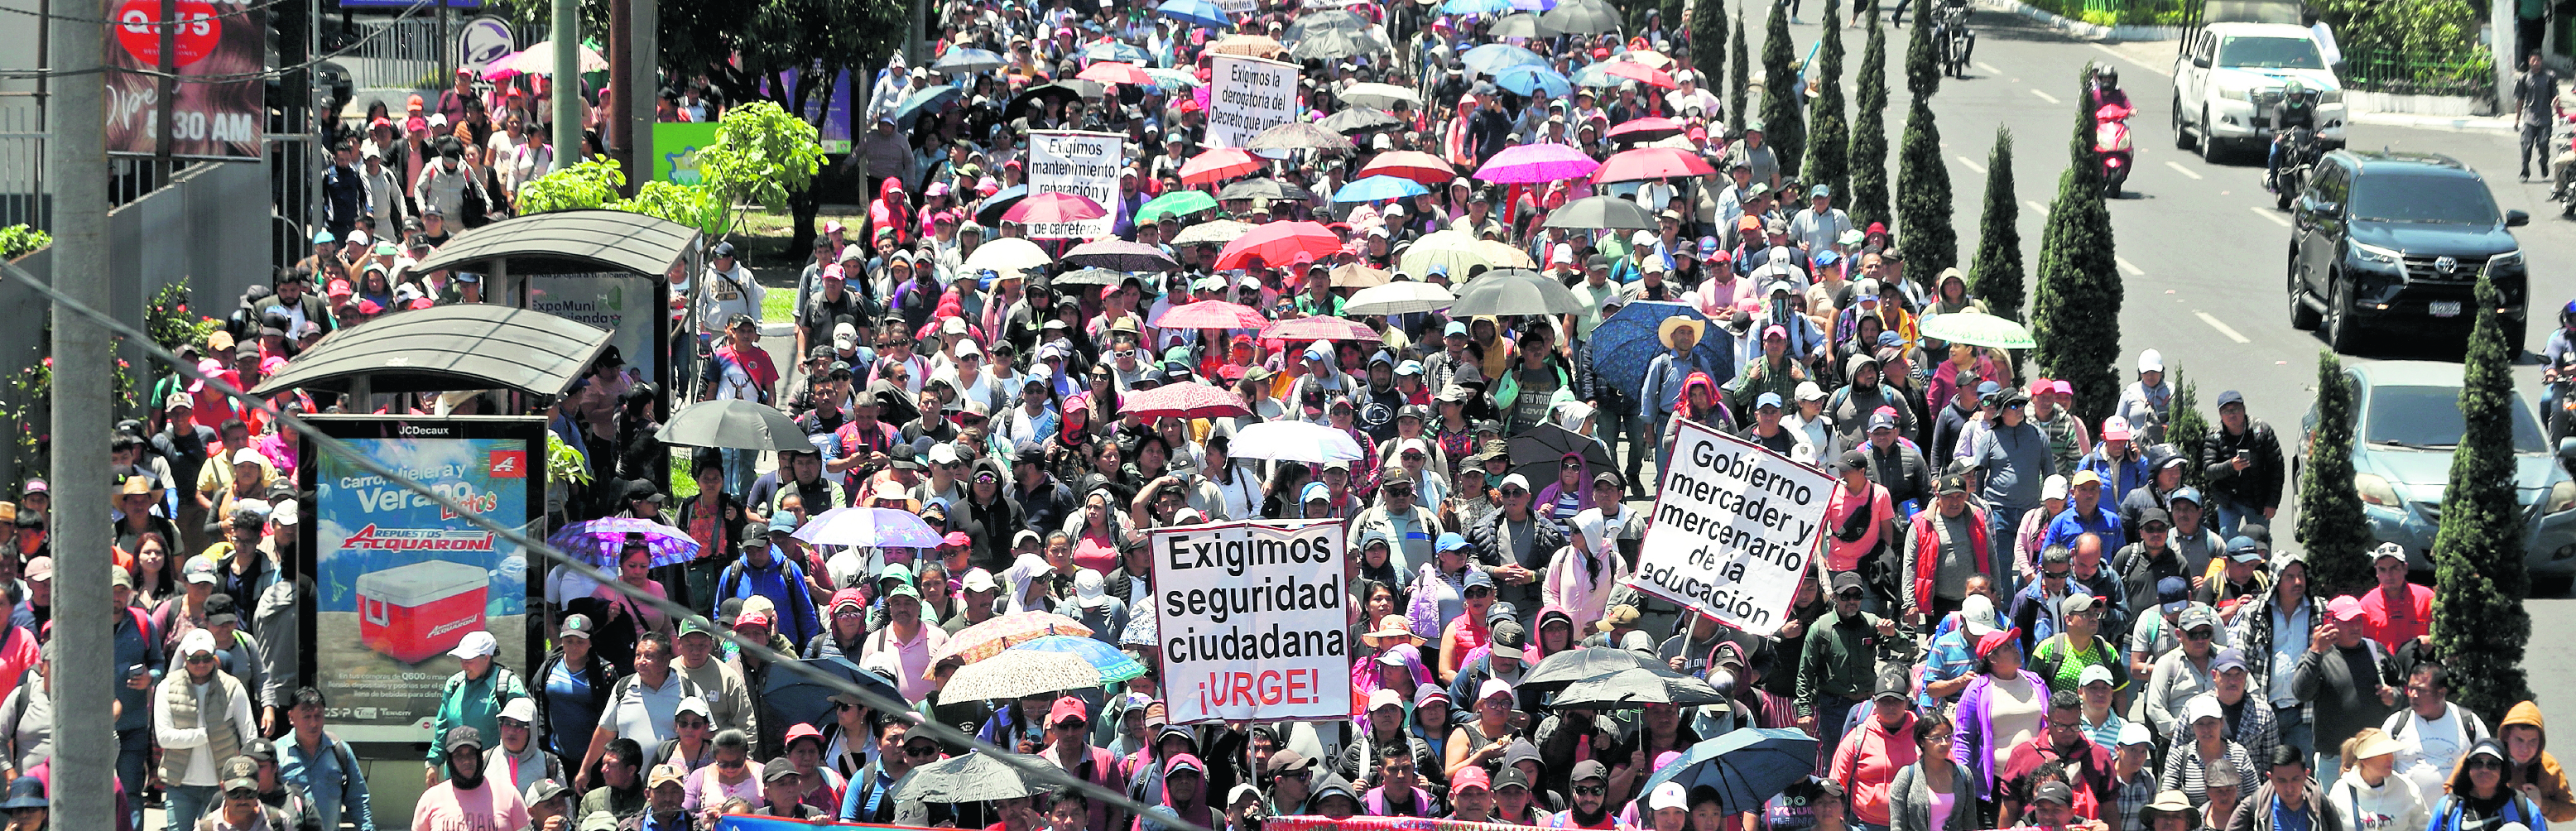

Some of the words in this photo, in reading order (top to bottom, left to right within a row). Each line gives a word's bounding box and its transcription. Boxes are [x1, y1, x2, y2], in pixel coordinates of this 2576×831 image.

[1232, 64, 1270, 89] Exigimos
[1272, 69, 1281, 89] la
[1222, 85, 1270, 111] derogatoria
[1271, 93, 1286, 112] del
[211, 112, 252, 142] AM
[1211, 105, 1242, 129] Decreto
[1243, 115, 1261, 134] que
[1049, 137, 1103, 159] Exigimos
[1031, 159, 1118, 181] mantenimiento,
[1102, 186, 1109, 204] y
[1050, 219, 1102, 236] carreteras
[1521, 393, 1535, 404] NEW
[399, 425, 449, 435] JCDecaux
[340, 474, 387, 489] Carro,
[455, 464, 467, 478] y
[1692, 440, 1811, 506] Gobierno
[356, 481, 473, 514] Verano
[1669, 471, 1793, 533] mercader
[1791, 519, 1814, 547] y
[1658, 502, 1802, 572] mercenario
[1168, 530, 1332, 577] Exigimos
[1689, 545, 1715, 571] de
[1165, 573, 1340, 624] seguridad
[1640, 562, 1771, 627] educación
[1167, 622, 1346, 664] ciudadana
[401, 672, 426, 680] Q600
[1199, 668, 1319, 716] ¡URGE!
